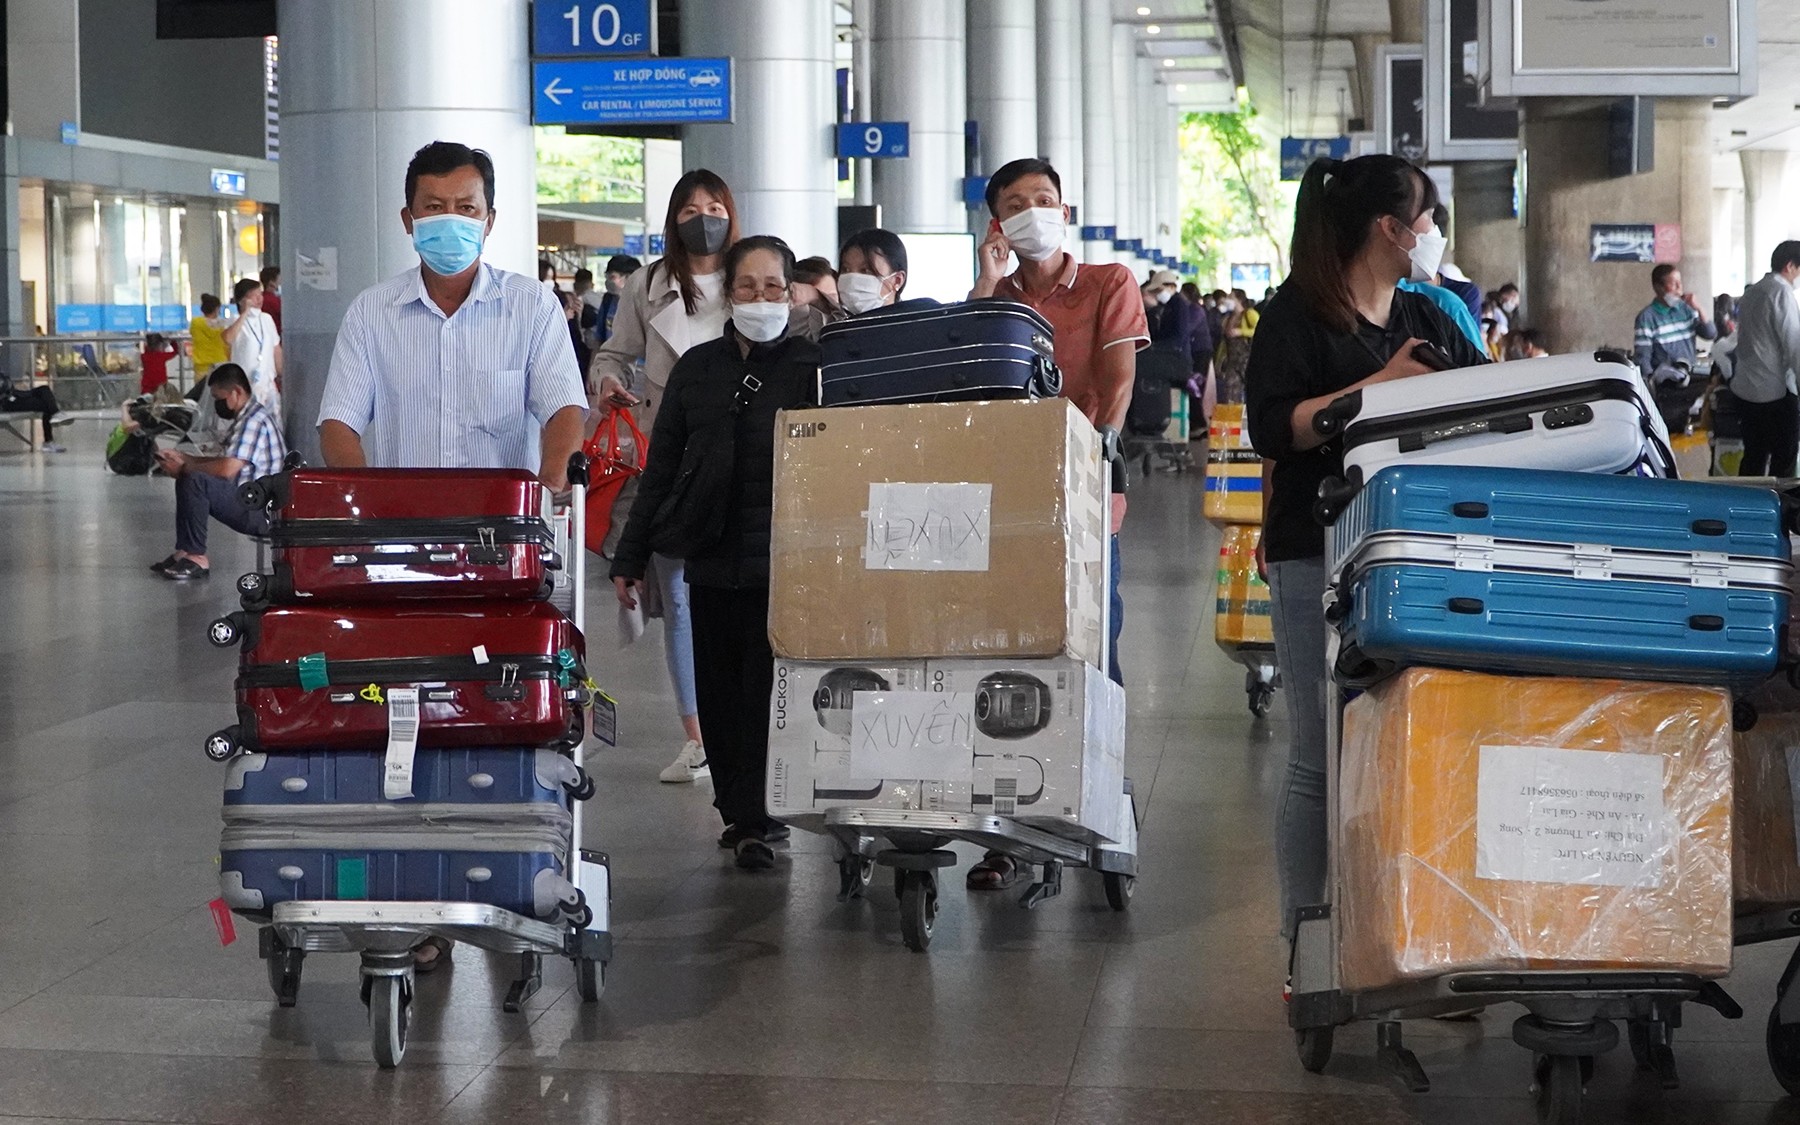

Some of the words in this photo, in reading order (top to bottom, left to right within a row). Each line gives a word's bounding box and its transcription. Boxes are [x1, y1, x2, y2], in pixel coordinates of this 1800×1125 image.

[563, 3, 621, 47] 10
[622, 33, 642, 46] GF
[613, 69, 626, 81] XE
[582, 100, 599, 110] CAR
[601, 100, 632, 110] RENTAL
[688, 98, 722, 108] SERVICE
[865, 126, 883, 154] 9
[777, 666, 787, 730] CUCKOO
[1608, 811, 1622, 821] An
[1534, 827, 1541, 836] 2
